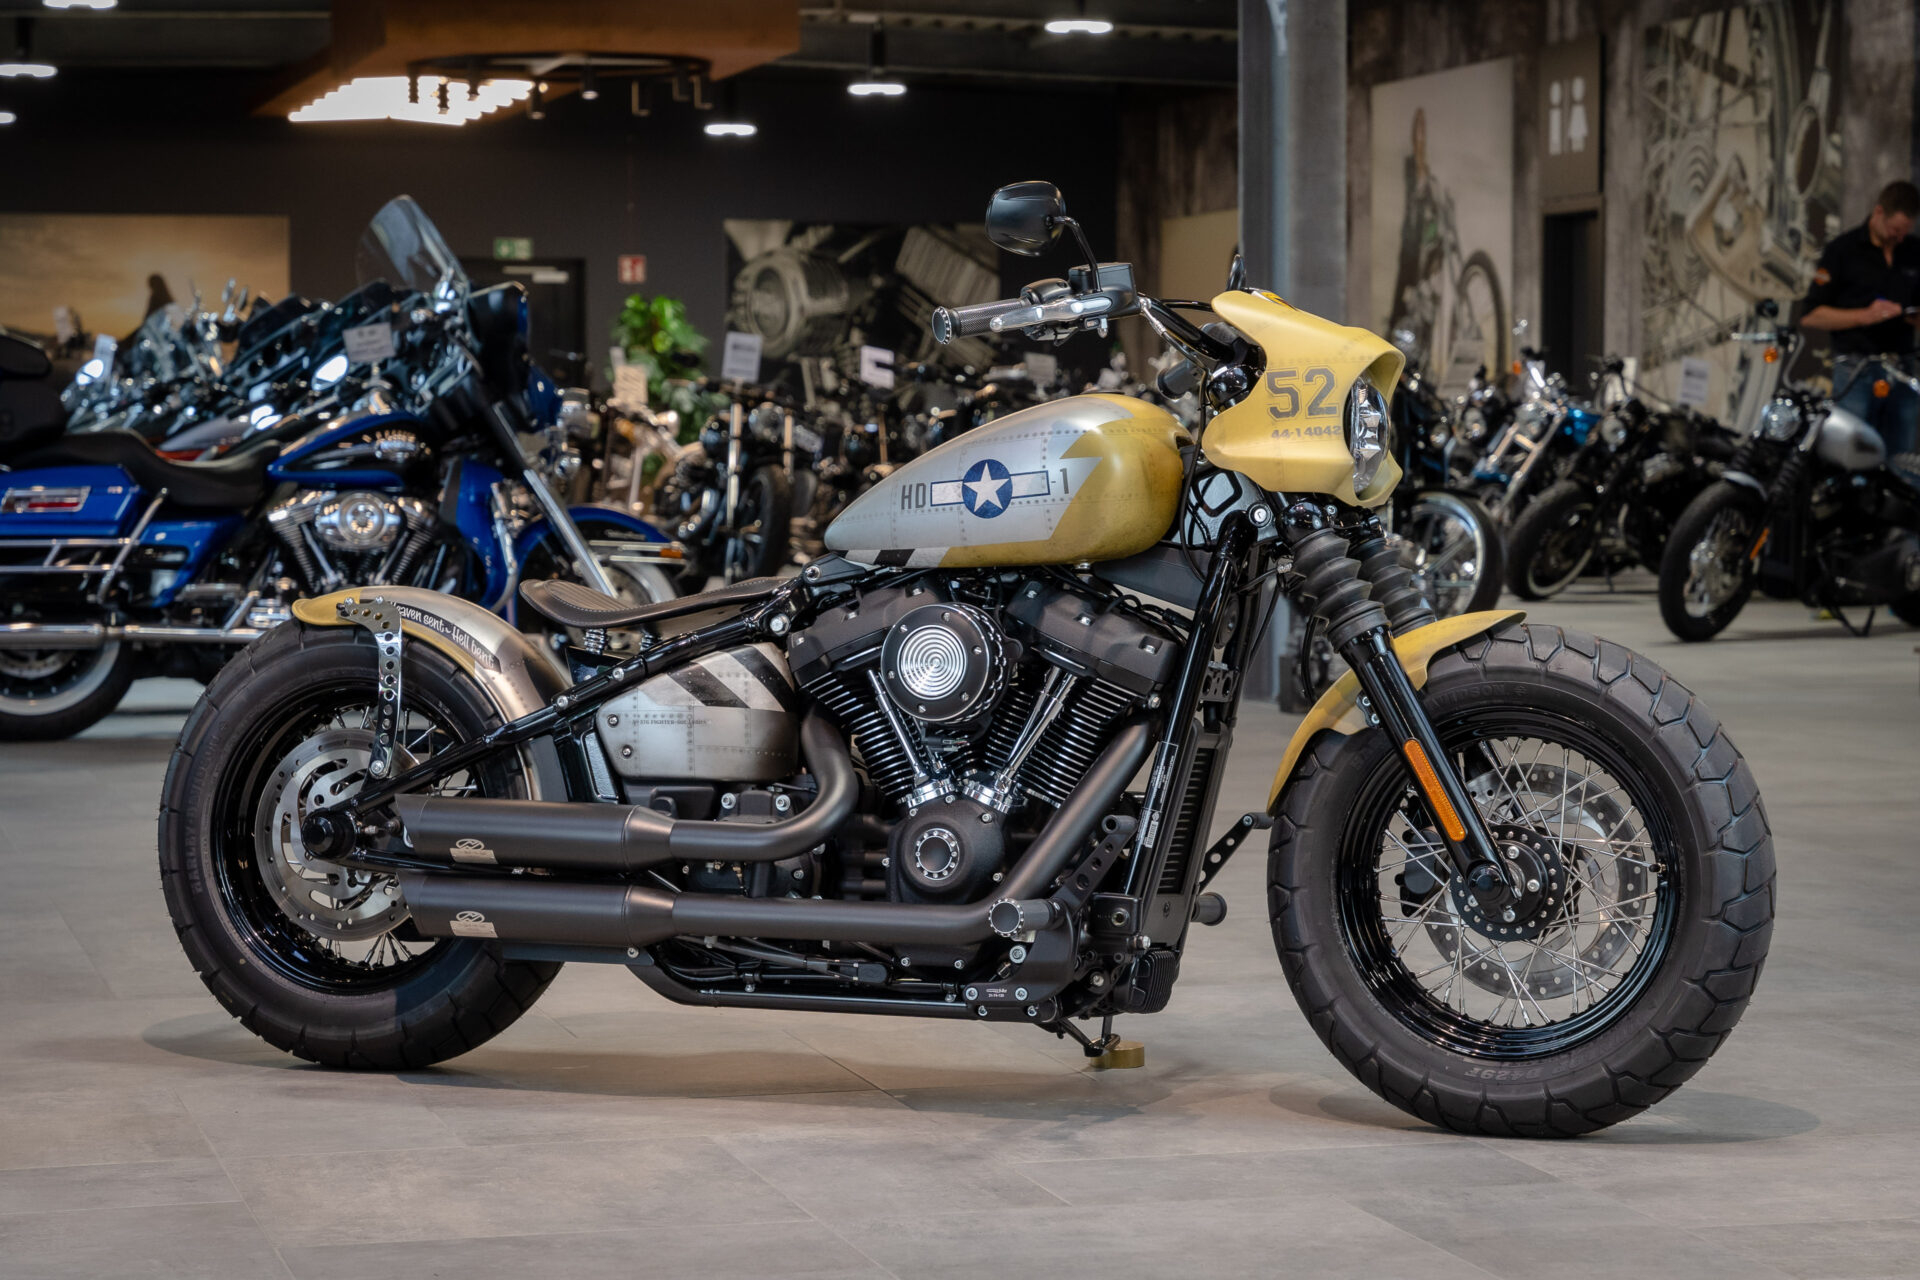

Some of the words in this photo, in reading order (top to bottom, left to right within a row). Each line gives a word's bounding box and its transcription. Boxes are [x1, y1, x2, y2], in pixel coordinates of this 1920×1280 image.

[1265, 366, 1341, 421] 52
[900, 482, 927, 510] HD
[451, 626, 470, 650] Hell
[470, 640, 495, 669] bent
